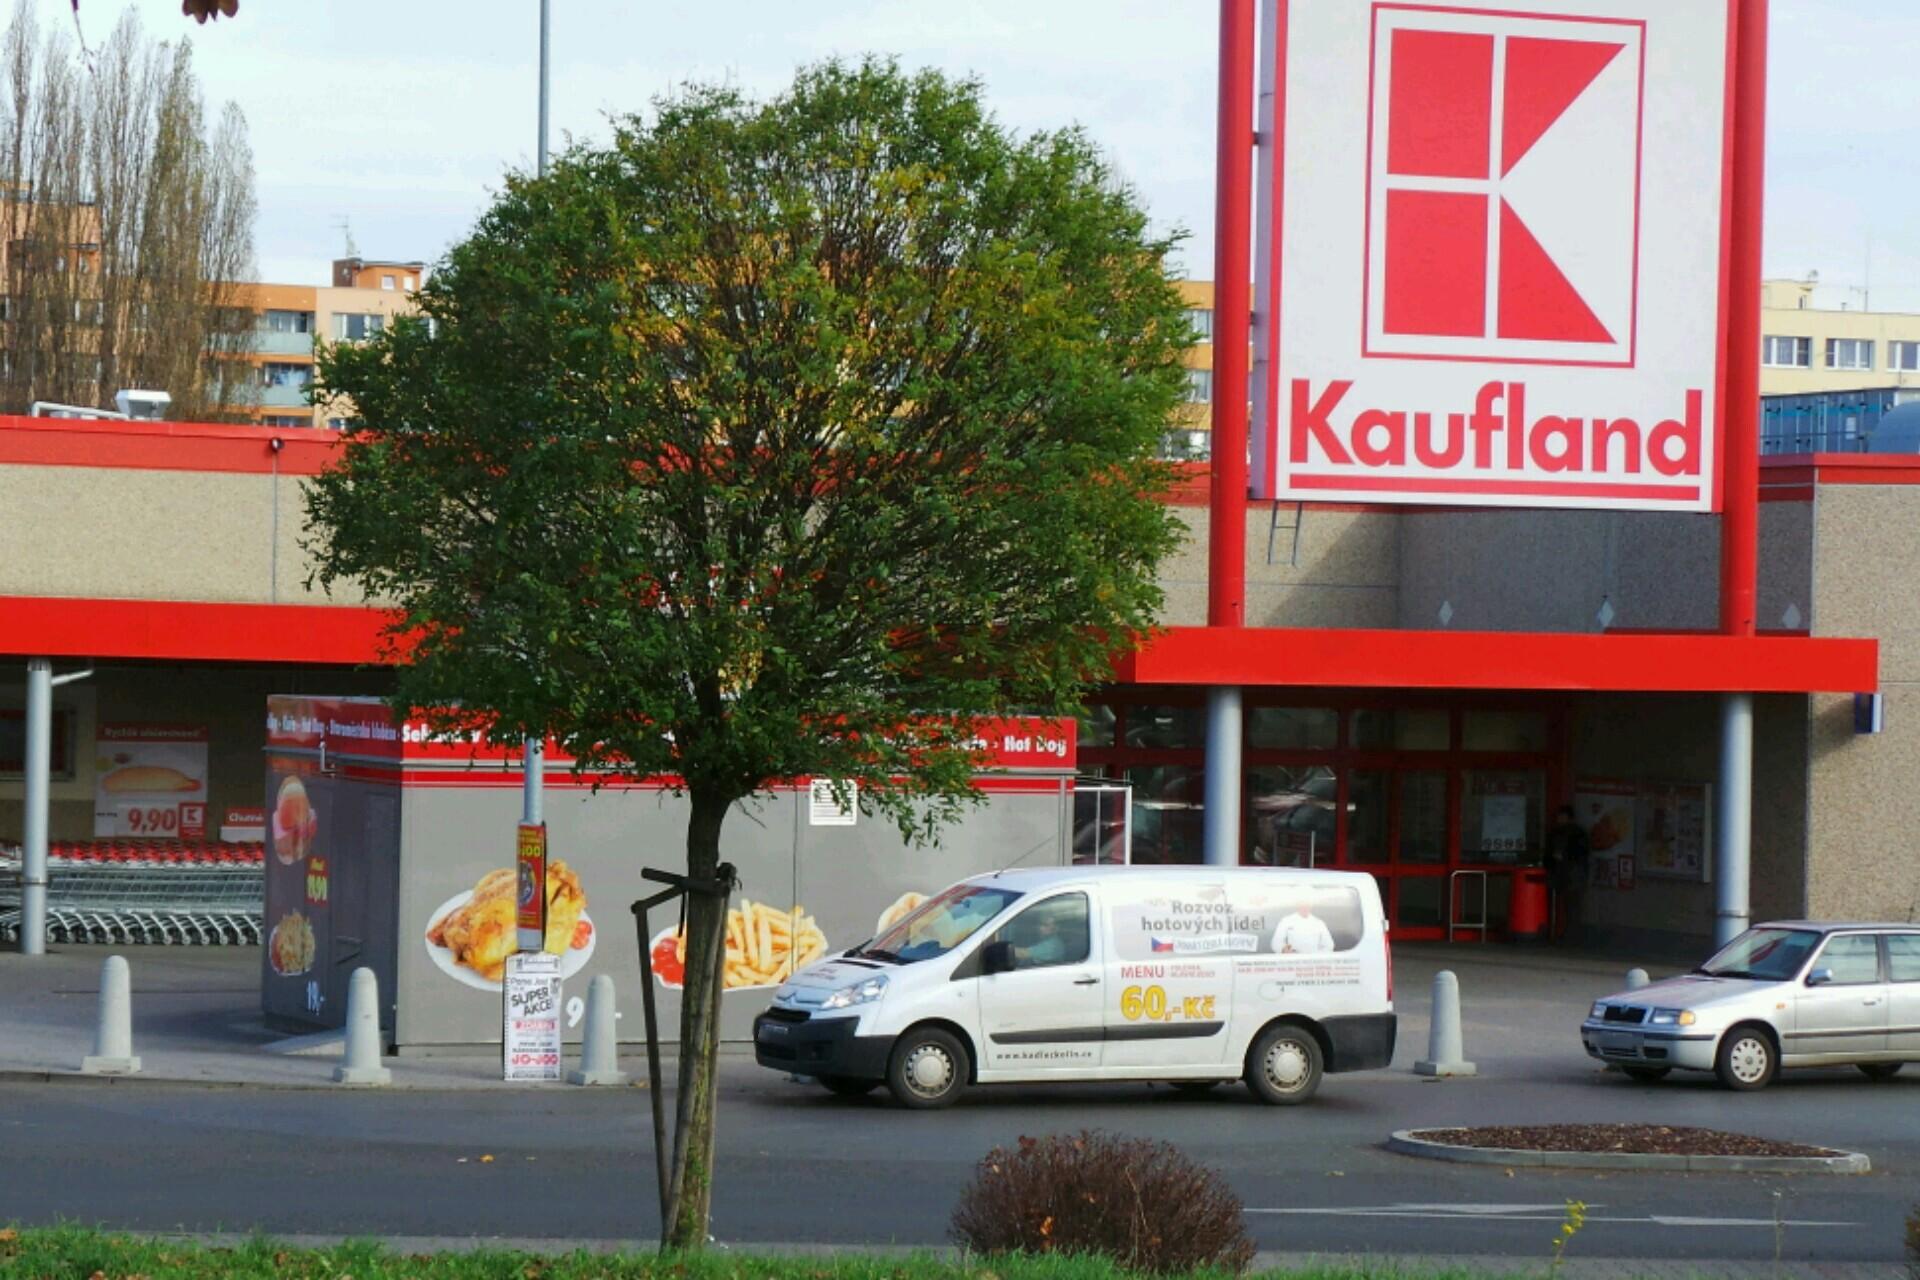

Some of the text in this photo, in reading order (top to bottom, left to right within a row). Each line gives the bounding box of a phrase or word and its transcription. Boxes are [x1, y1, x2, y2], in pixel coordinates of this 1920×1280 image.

[1290, 379, 1703, 476] Kaufland
[1004, 735, 1031, 752] Hot
[1035, 735, 1067, 757] Dog
[128, 808, 176, 833] 9,90
[1172, 900, 1233, 914] Rozvoz
[1141, 916, 1223, 935] hotových
[1121, 965, 1165, 978] MENU
[511, 986, 549, 1007] SUPER
